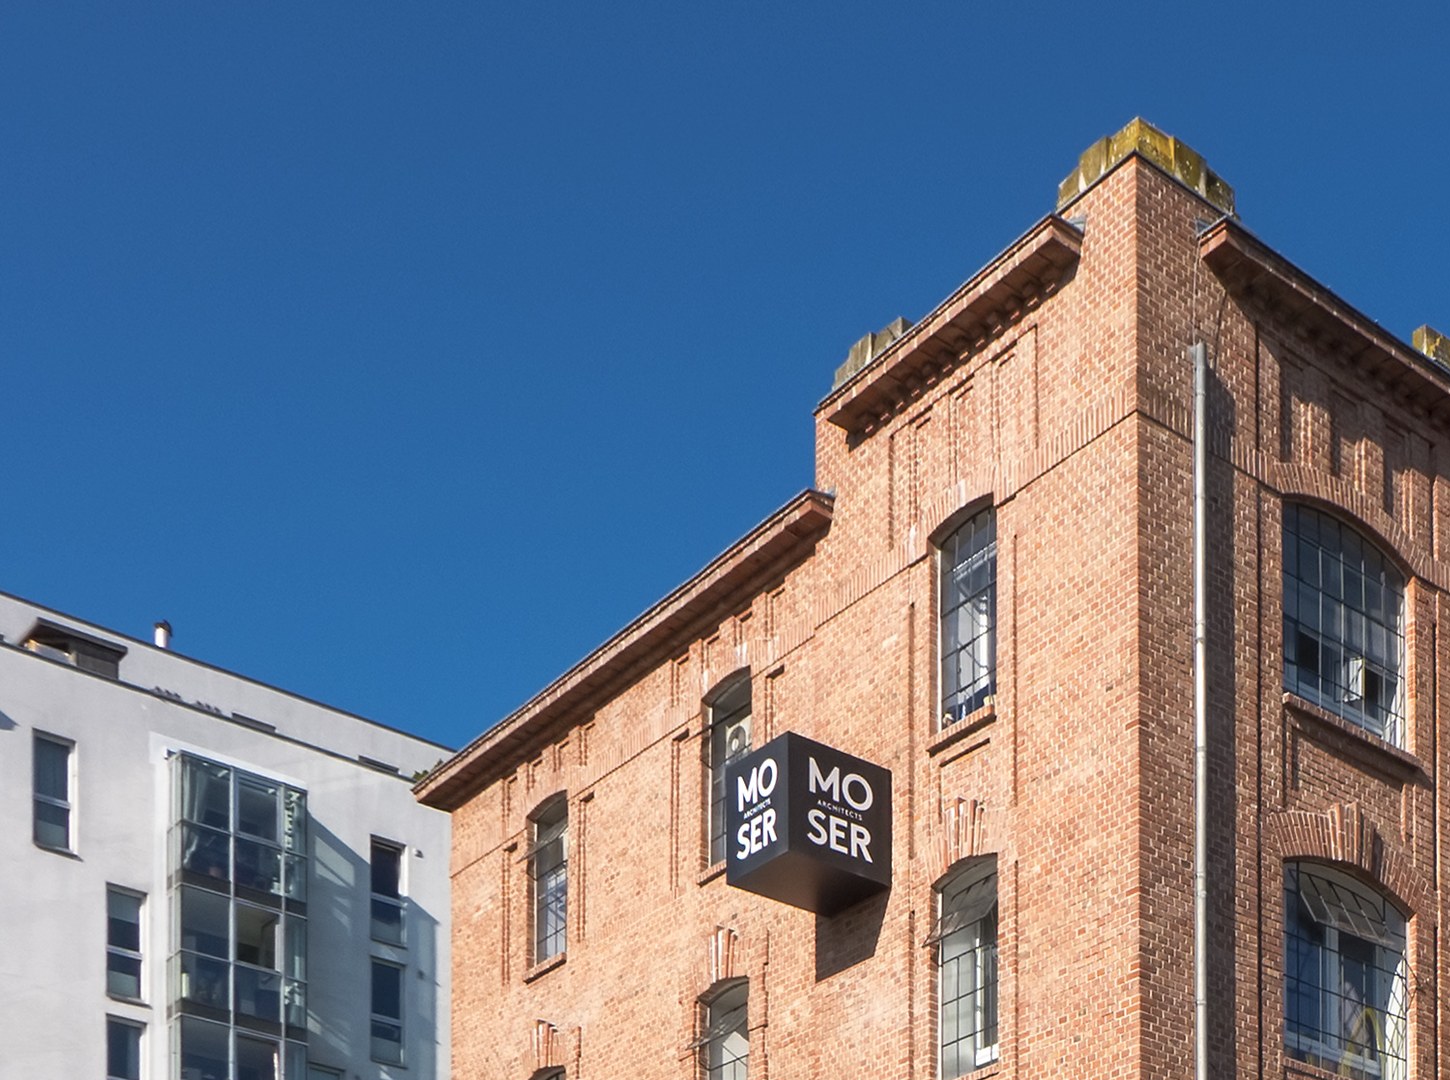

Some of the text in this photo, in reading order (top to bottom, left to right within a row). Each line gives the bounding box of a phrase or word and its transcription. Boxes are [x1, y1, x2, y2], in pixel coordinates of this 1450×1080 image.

[737, 757, 778, 813] MO
[808, 756, 874, 811] MO
[817, 799, 863, 822] ARCHITECTS
[736, 808, 778, 860] SER
[807, 808, 873, 864] SER
